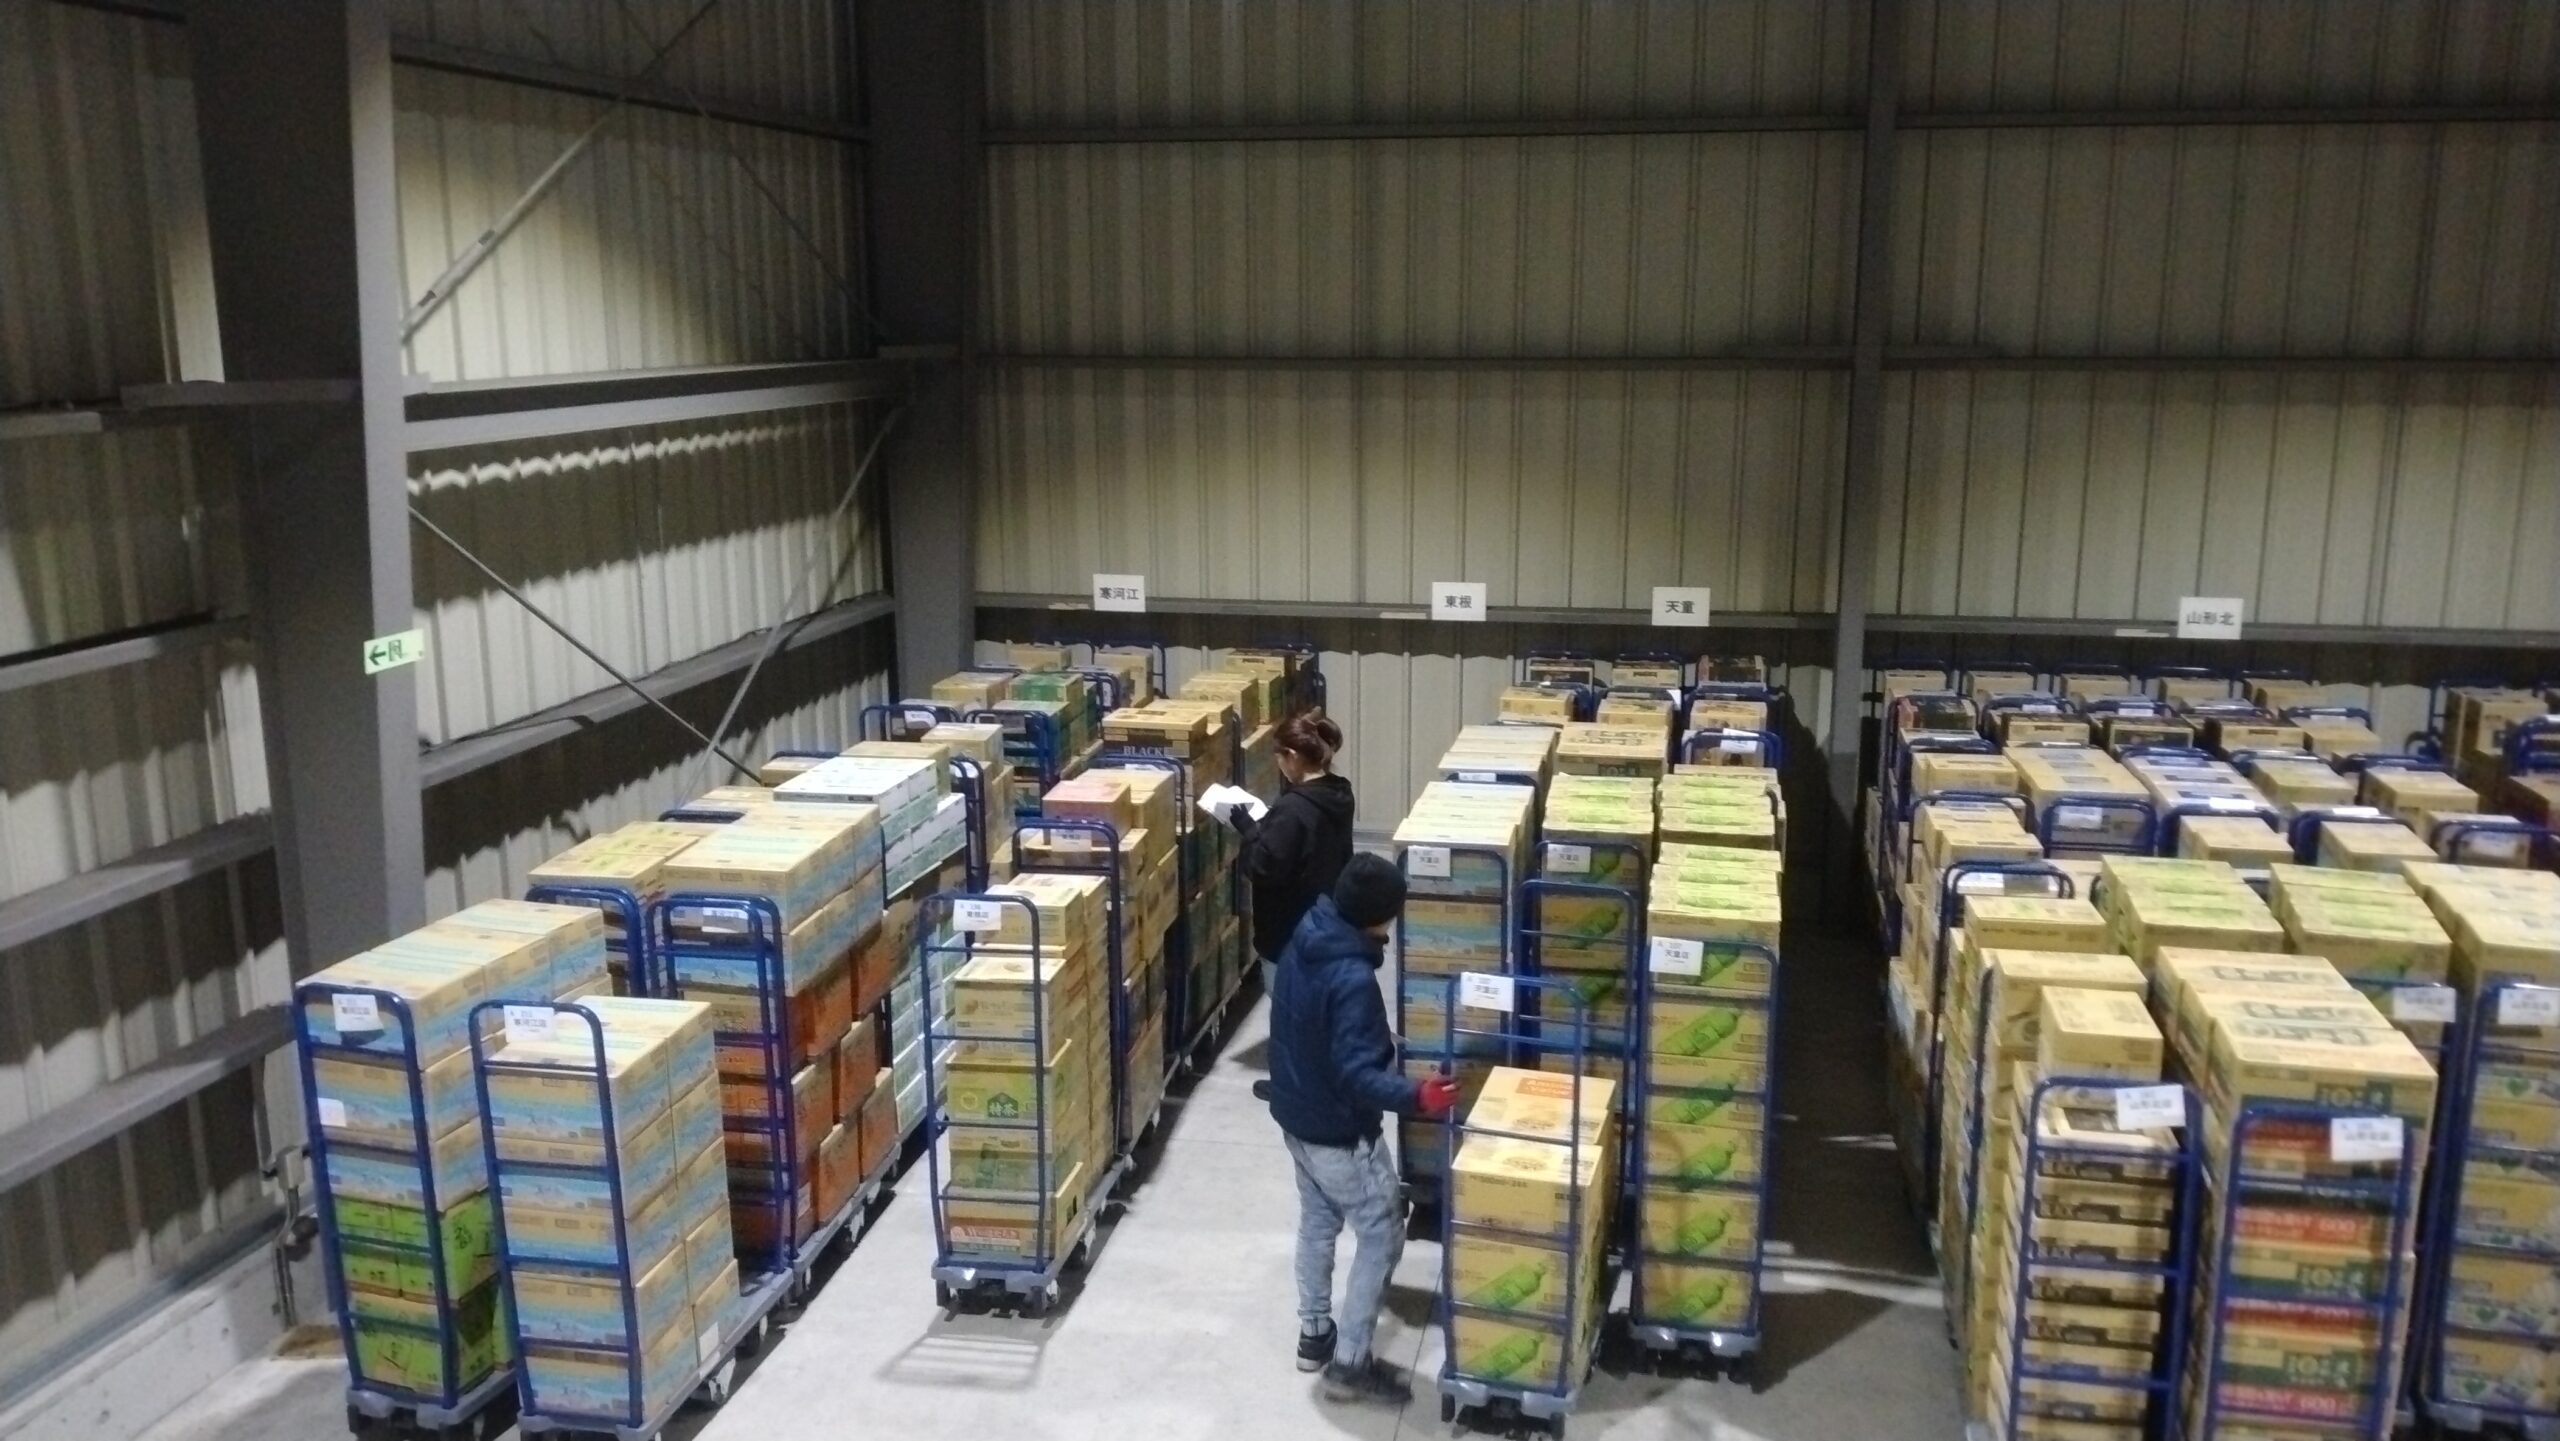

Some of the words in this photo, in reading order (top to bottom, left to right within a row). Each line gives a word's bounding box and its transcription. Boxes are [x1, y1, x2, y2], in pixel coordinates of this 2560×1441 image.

[1099, 587, 1139, 600] 寒河江
[1444, 595, 1472, 608] 東根
[1665, 600, 1695, 614] 天童
[2186, 610, 2234, 625] 山形北
[989, 1102, 1017, 1116] 特茶
